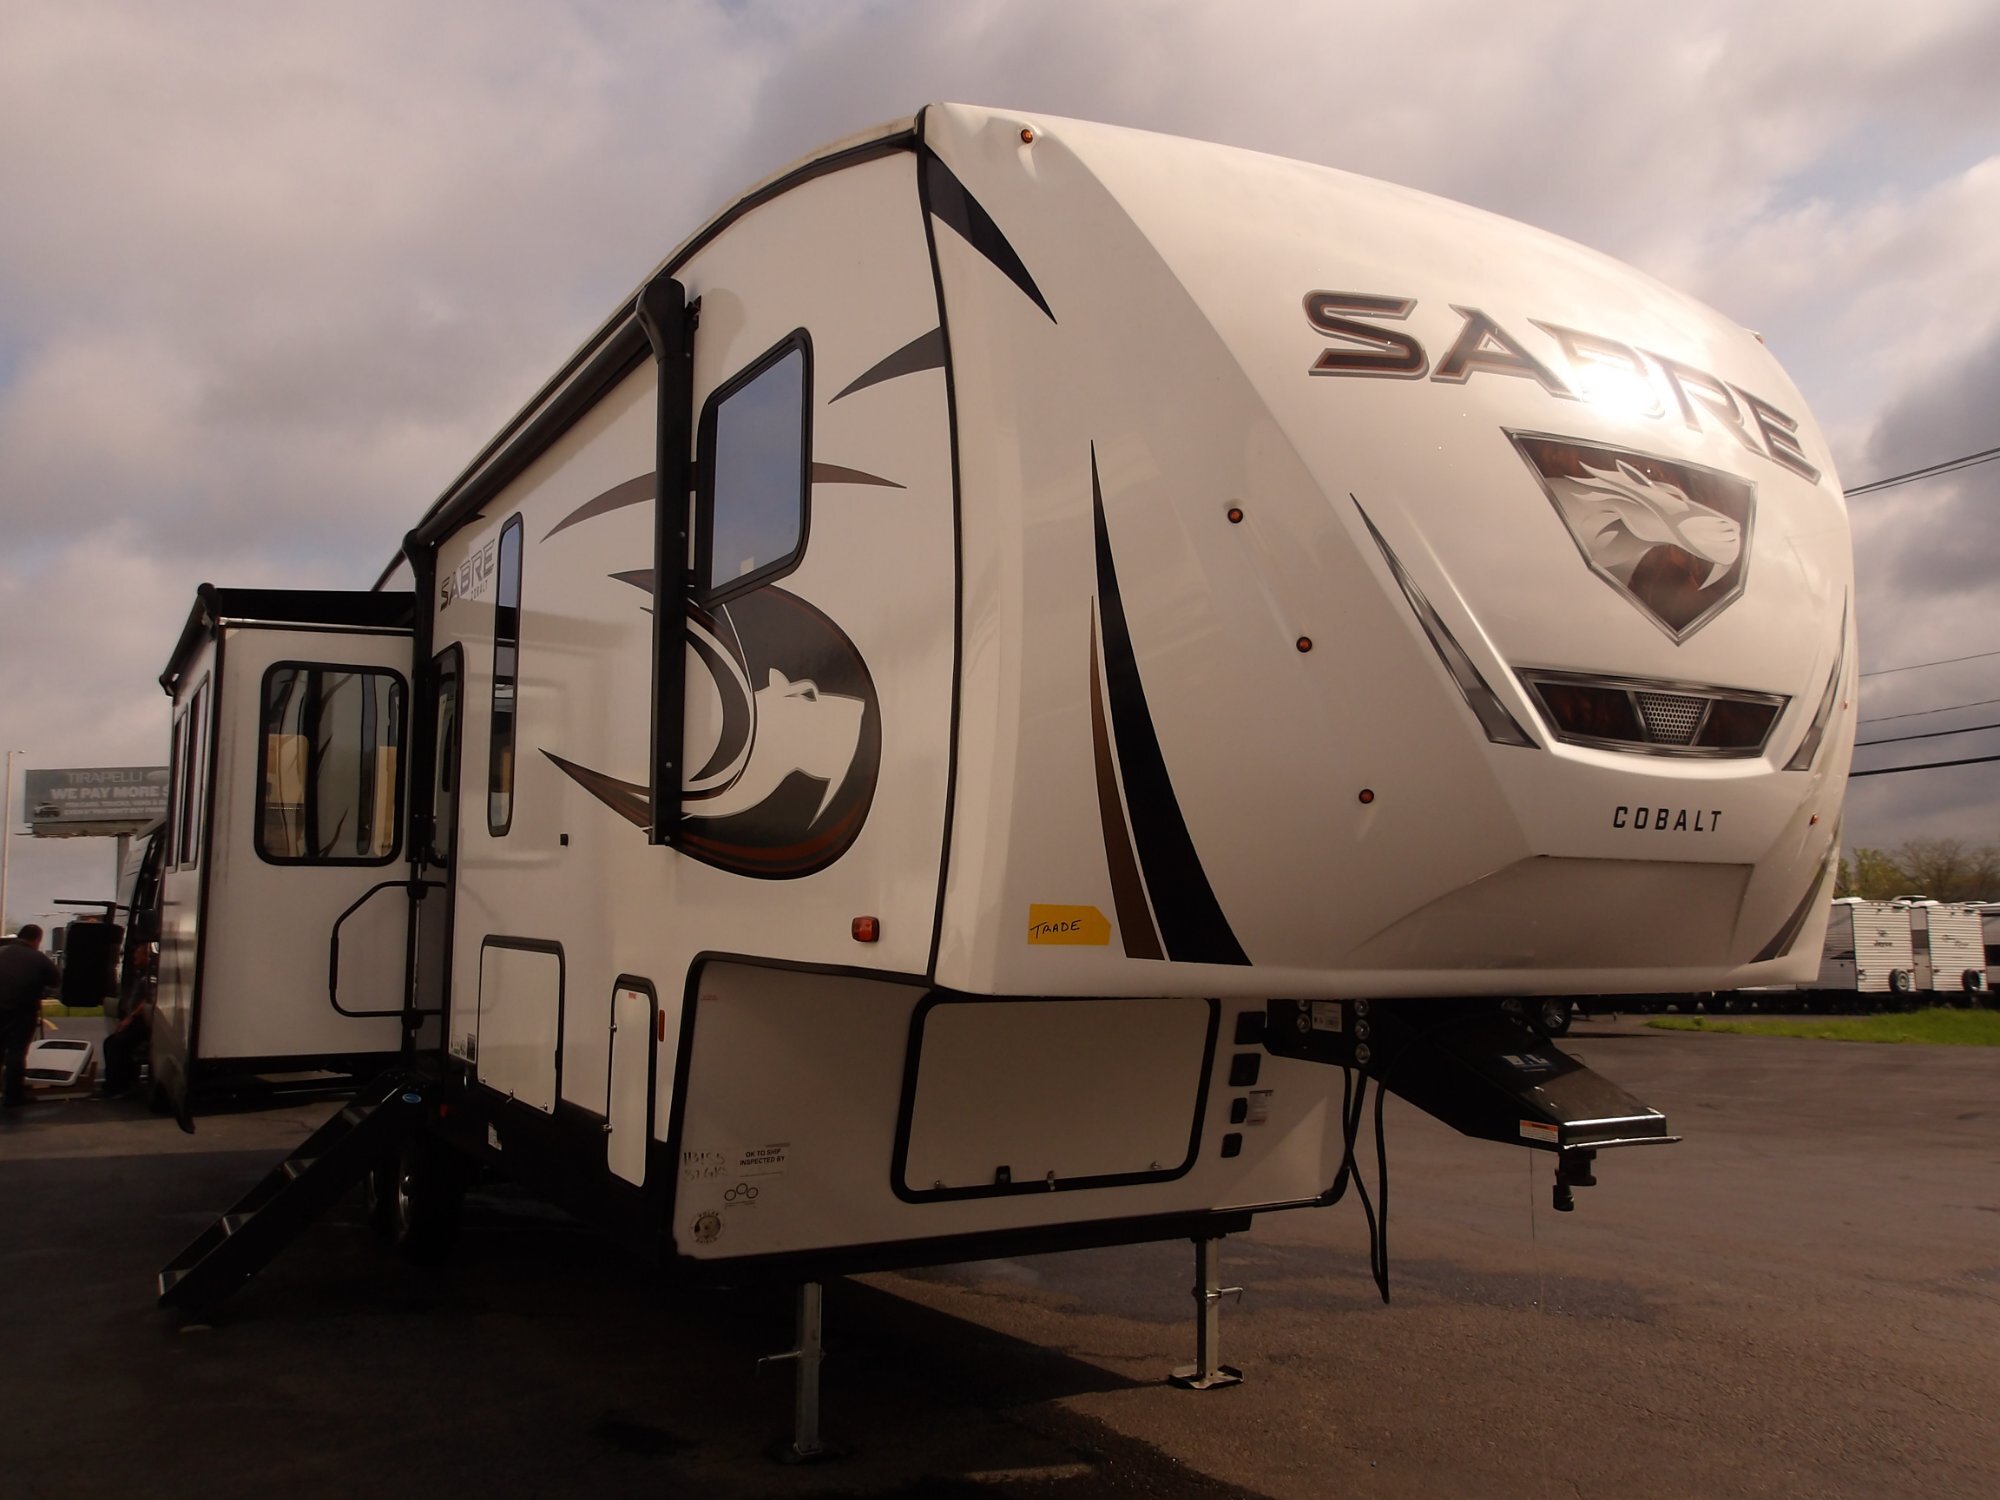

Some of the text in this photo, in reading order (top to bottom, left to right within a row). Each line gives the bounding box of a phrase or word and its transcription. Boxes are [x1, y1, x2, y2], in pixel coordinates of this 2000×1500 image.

[1302, 289, 1822, 486] SABRE
[440, 538, 495, 612] SABRE
[67, 771, 143, 784] TIRAPELLI
[51, 788, 78, 800] WE
[80, 787, 110, 799] PAY
[113, 785, 160, 798] MORE
[1613, 806, 1722, 832] COBALT
[1030, 919, 1082, 939] TRADE
[766, 1148, 782, 1156] SHIP
[739, 1156, 775, 1166] INSPECTED
